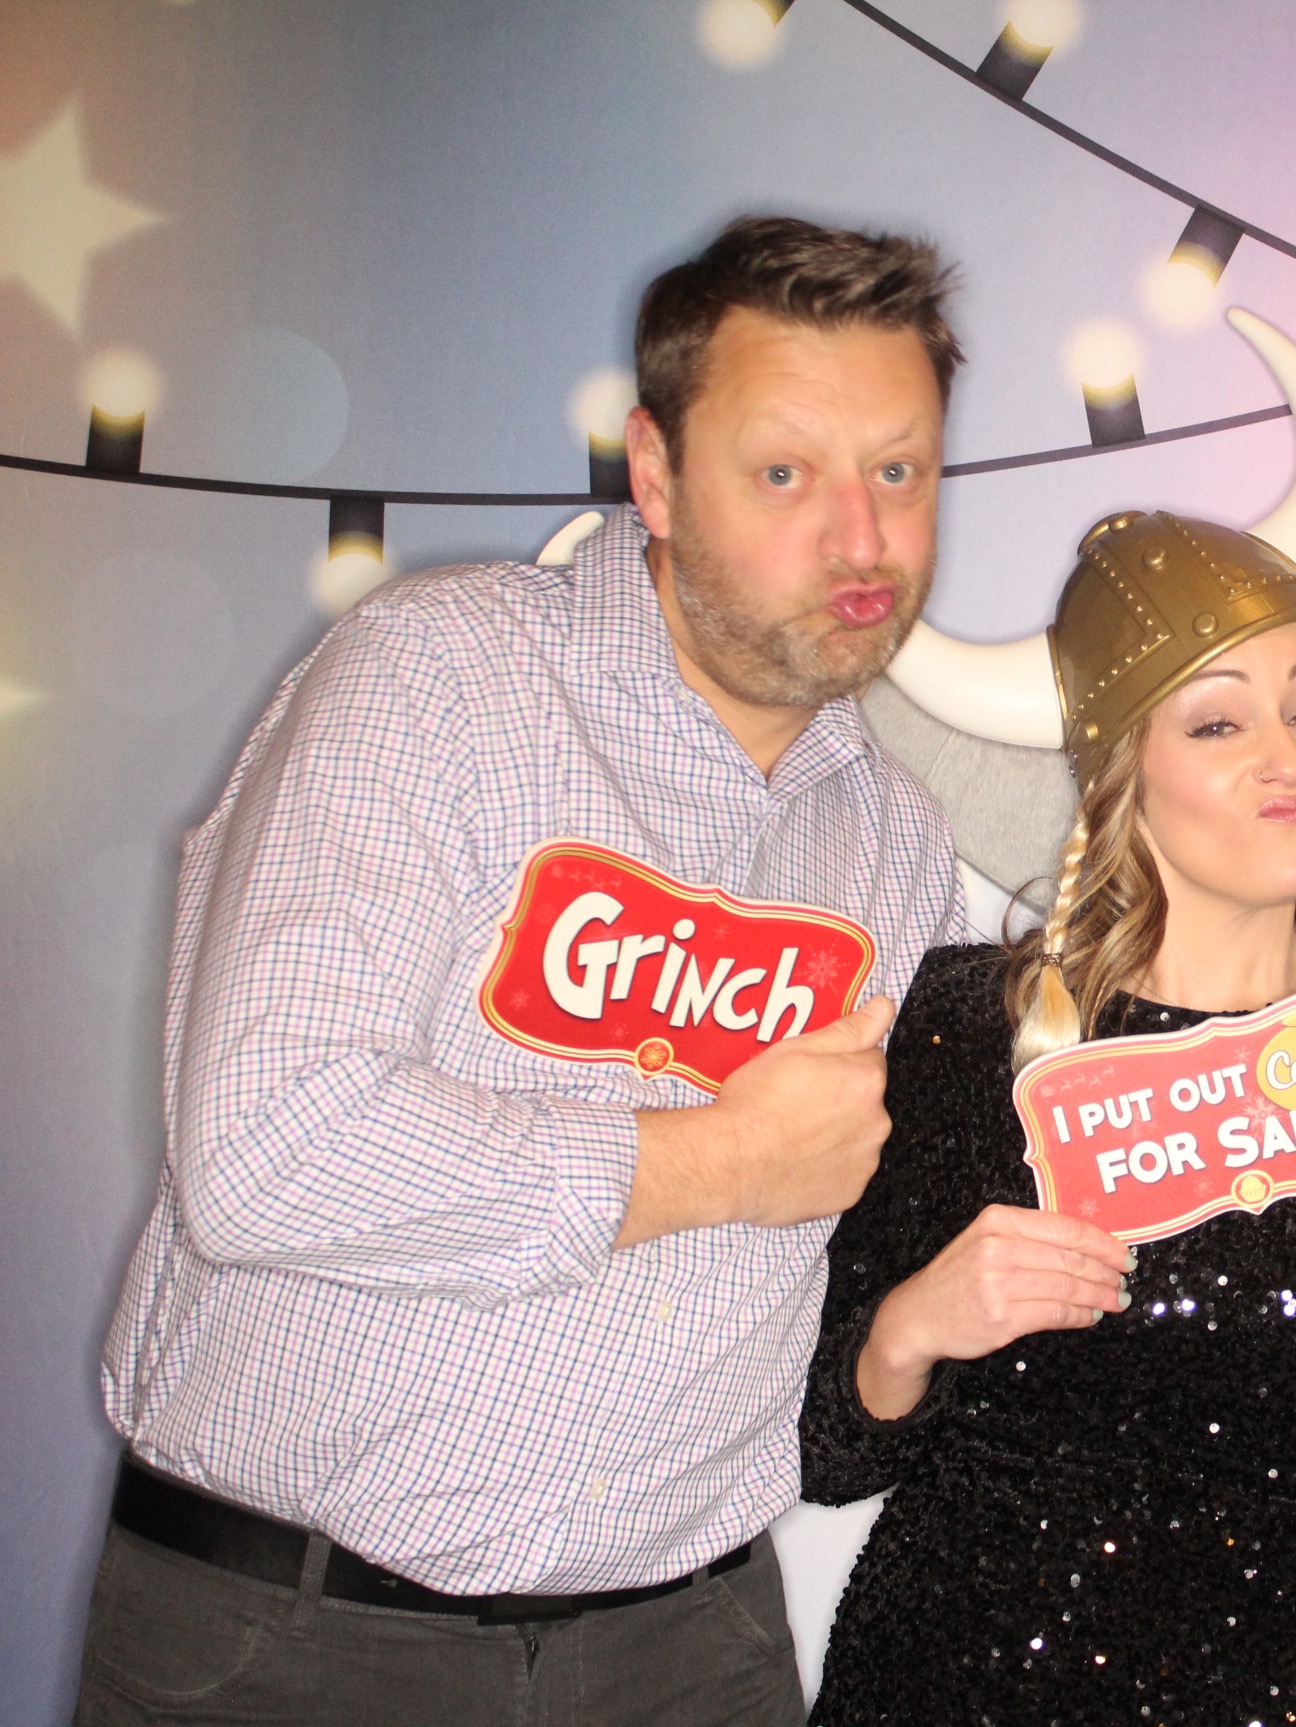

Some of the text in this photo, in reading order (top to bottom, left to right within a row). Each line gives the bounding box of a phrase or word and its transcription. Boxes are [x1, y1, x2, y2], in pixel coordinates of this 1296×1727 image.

[543, 891, 814, 1043] Grinch
[1052, 1105, 1071, 1143] I
[1079, 1088, 1154, 1137] PUT
[1169, 1064, 1247, 1113] OUT
[1096, 1132, 1206, 1194] FOR
